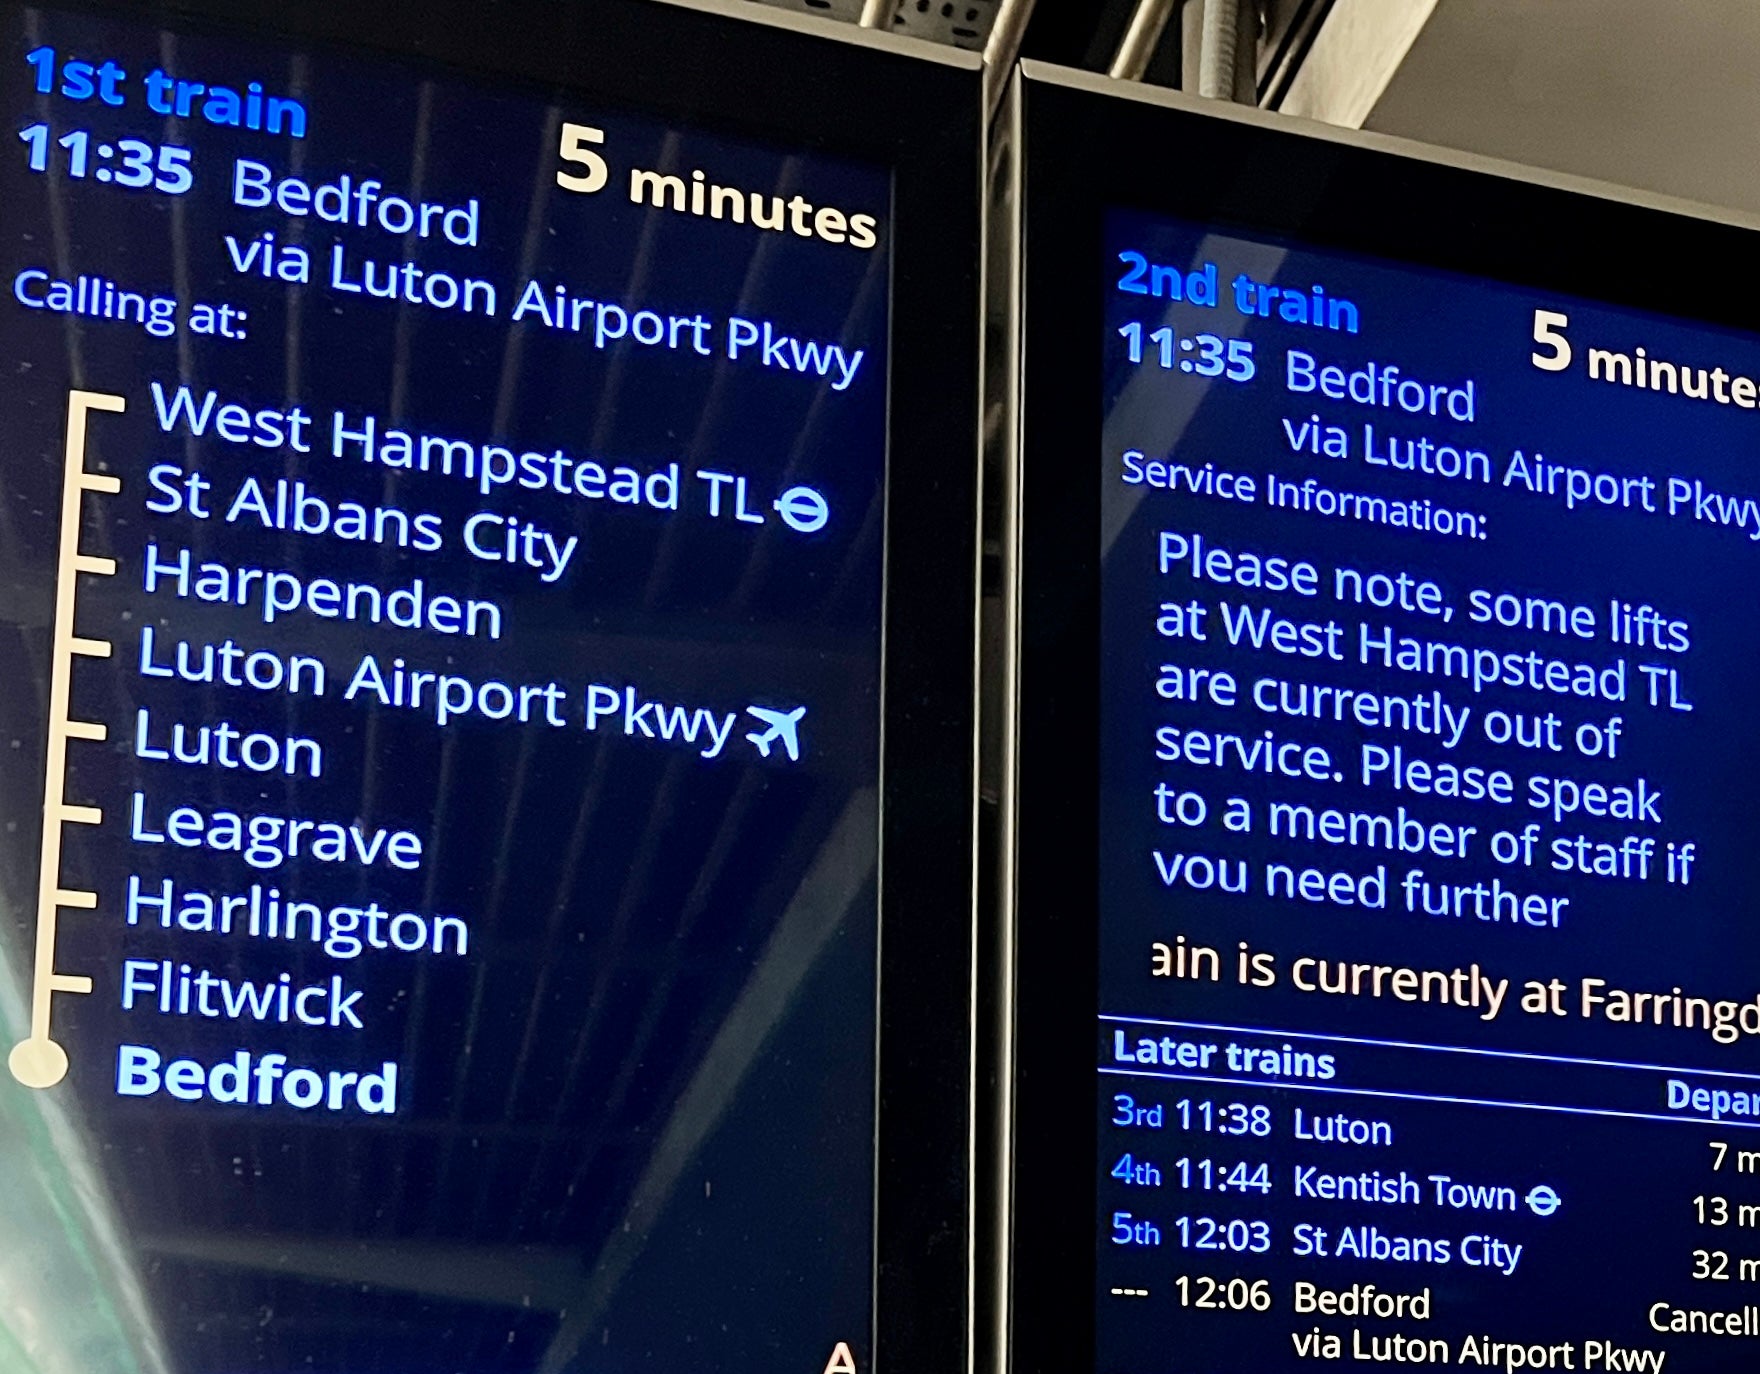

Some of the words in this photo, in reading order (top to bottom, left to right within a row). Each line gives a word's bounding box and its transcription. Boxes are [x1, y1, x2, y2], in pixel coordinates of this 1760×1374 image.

[26, 47, 126, 106] 1st
[143, 69, 306, 139] train
[18, 124, 193, 194] 11:35
[234, 159, 479, 247] Bedford
[556, 122, 608, 193] 5
[630, 168, 877, 249] minutes
[14, 270, 177, 337] Calling
[188, 303, 247, 340] at:
[224, 232, 310, 284] via
[331, 244, 496, 317] Luton
[512, 279, 712, 356] Airport
[727, 317, 864, 391] Pkwy
[1117, 251, 1218, 308] 2nd
[1231, 272, 1359, 334] train
[1118, 322, 1256, 382] 11:35
[1286, 349, 1474, 423] Bedford
[1532, 309, 1572, 371] 5
[150, 381, 312, 453] West
[332, 411, 679, 511] Hampstead
[696, 470, 765, 524] TL
[1282, 413, 1348, 459] via
[1364, 423, 1491, 484] Luton
[1502, 450, 1656, 513] Airport
[145, 464, 211, 519] St
[225, 477, 443, 552] Albans
[463, 513, 578, 583] City
[1121, 450, 1256, 502] Service
[1268, 474, 1487, 541] Information:
[145, 544, 501, 639] Harpenden
[1159, 531, 1319, 596] Please
[1334, 567, 1454, 623] note,
[1468, 589, 1596, 638] some
[1611, 599, 1690, 653] lifts
[140, 626, 325, 696] Luton
[344, 654, 567, 727] Airport
[586, 684, 737, 759] Pkwy
[1156, 599, 1207, 641] at
[1219, 601, 1344, 661] West
[1359, 622, 1626, 702] Hampstead
[1638, 664, 1693, 712] TL
[135, 708, 322, 778] Luton
[1155, 664, 1237, 706] are
[1253, 678, 1471, 749] currently
[1483, 710, 1563, 752] out
[1575, 716, 1623, 759] of
[1155, 726, 1343, 783] service.
[1362, 744, 1514, 804] Please
[1527, 775, 1662, 824] speak
[132, 792, 423, 870] Leagrave
[1153, 782, 1207, 827] to
[1222, 798, 1251, 833] a
[1269, 802, 1478, 859] member
[1490, 823, 1541, 867] of
[1551, 834, 1656, 880] staff
[1666, 842, 1696, 886] if
[127, 875, 468, 959] Harlington
[1266, 864, 1386, 909] need
[1400, 869, 1570, 928] further
[122, 960, 364, 1029] Flitwick
[1238, 941, 1276, 987] is
[1292, 957, 1509, 1021] currently
[1520, 978, 1568, 1016] at
[117, 1044, 398, 1114] Bedford
[1114, 1029, 1218, 1069] Later
[1224, 1041, 1337, 1080] trains
[1112, 1094, 1163, 1128] 3rd
[1175, 1098, 1272, 1137] 11:38
[1294, 1107, 1392, 1146] Luton
[1709, 1141, 1728, 1171] 7
[1110, 1153, 1161, 1187] 4th
[1175, 1157, 1273, 1195] 11:44
[1294, 1165, 1420, 1205] Kentish
[1427, 1175, 1516, 1212] Town
[1693, 1195, 1729, 1226] 13
[1111, 1212, 1160, 1246] 5th
[1175, 1216, 1271, 1253] 12:03
[1292, 1223, 1328, 1257] St
[1334, 1226, 1451, 1264] Albans
[1460, 1234, 1523, 1276] City
[1692, 1249, 1730, 1280] 32
[1175, 1275, 1271, 1312] 12:06
[1294, 1281, 1430, 1320] Bedford
[1291, 1326, 1341, 1359] via
[1353, 1328, 1449, 1364] Luton
